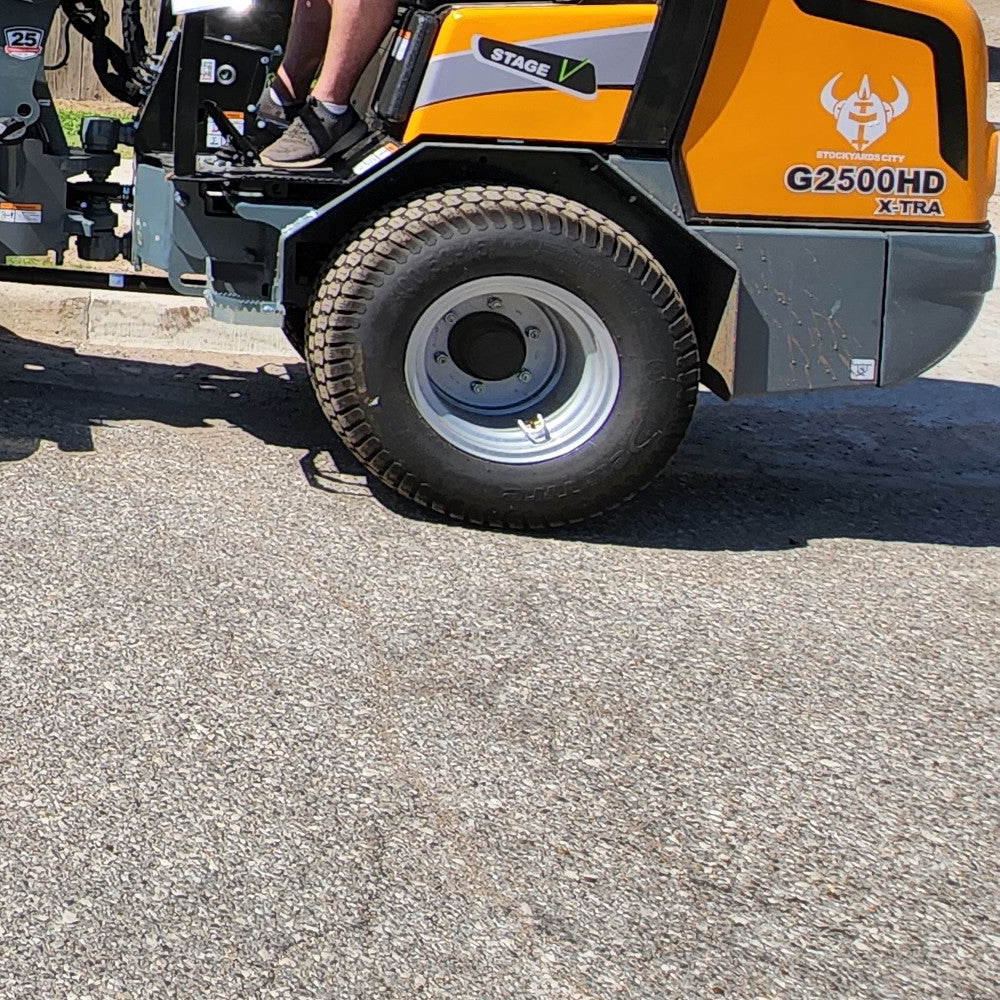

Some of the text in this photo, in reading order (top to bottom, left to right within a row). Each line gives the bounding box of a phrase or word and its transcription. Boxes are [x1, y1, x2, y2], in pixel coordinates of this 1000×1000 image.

[12, 32, 37, 47] 25
[490, 47, 551, 78] STAGE
[816, 150, 906, 163] STOCKYARDS CITY
[784, 164, 947, 196] G2500HD
[873, 197, 945, 217] X-TRA
